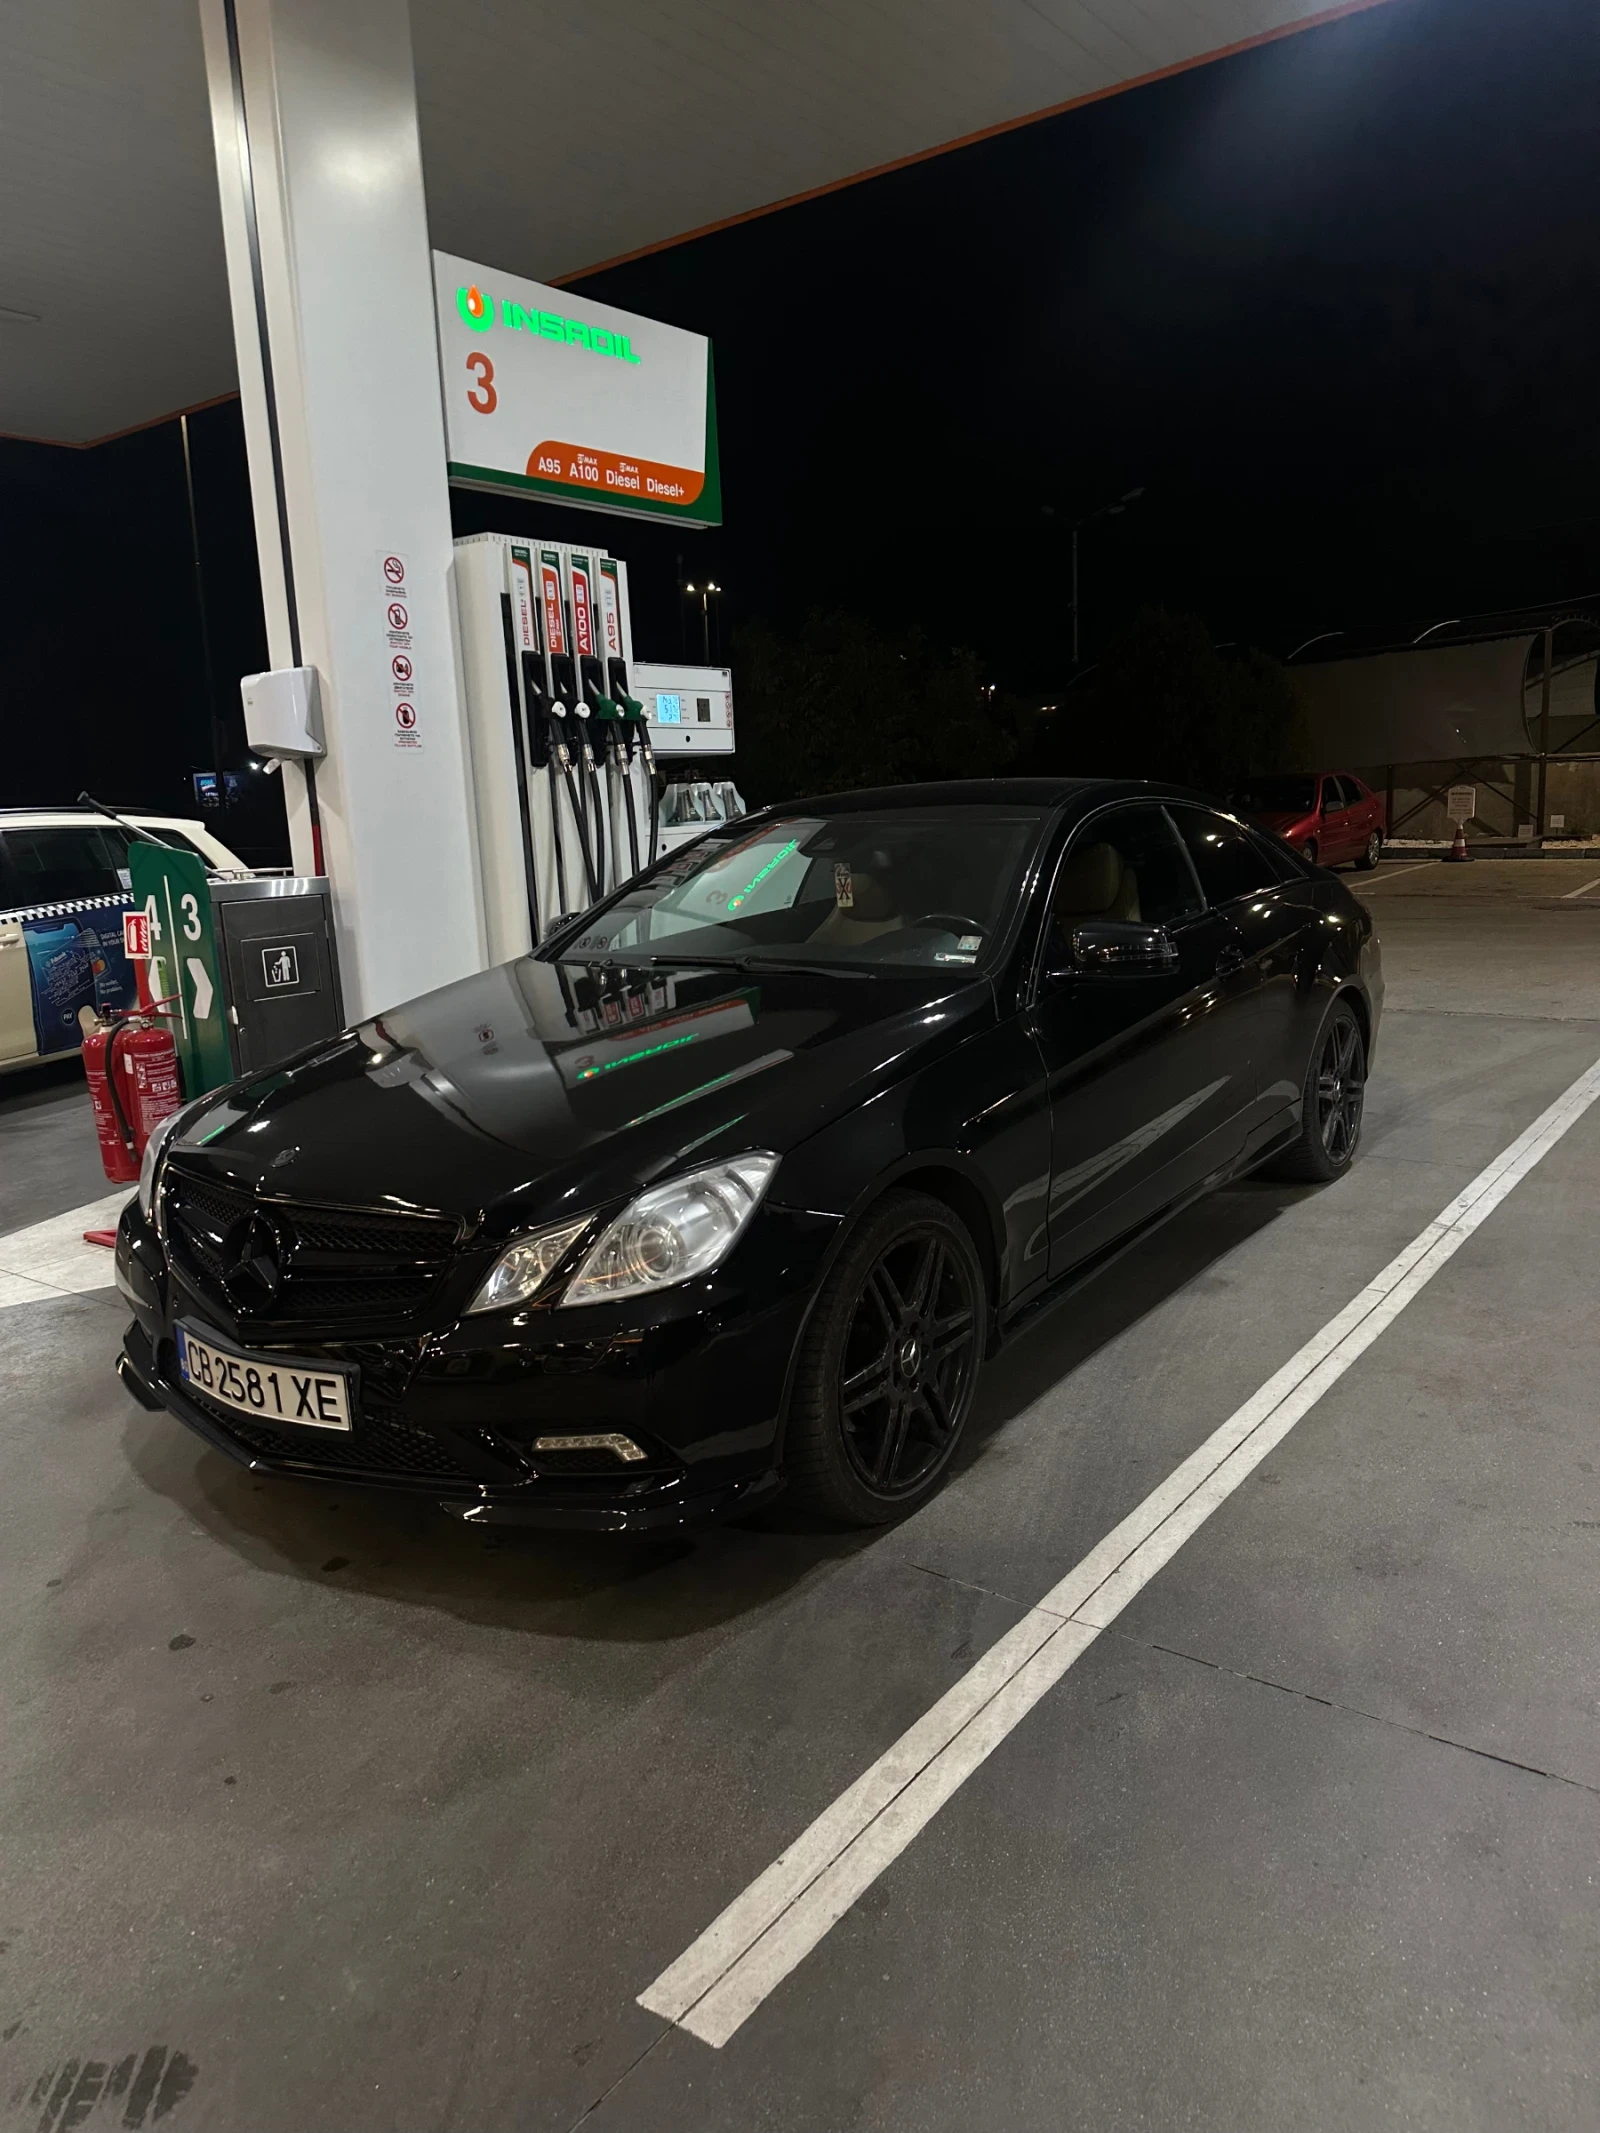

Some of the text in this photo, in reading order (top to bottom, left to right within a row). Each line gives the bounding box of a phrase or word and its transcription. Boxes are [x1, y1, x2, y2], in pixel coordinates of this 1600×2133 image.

[502, 299, 641, 365] INSAOIL
[465, 351, 498, 415] 3
[537, 455, 686, 498] A95 A100 Diesel Diesel+
[547, 602, 558, 649] DIESEL
[577, 607, 590, 652] A100
[606, 611, 618, 653] A95
[144, 893, 202, 941] 4 3
[187, 1340, 342, 1423] CB 2581 XE
